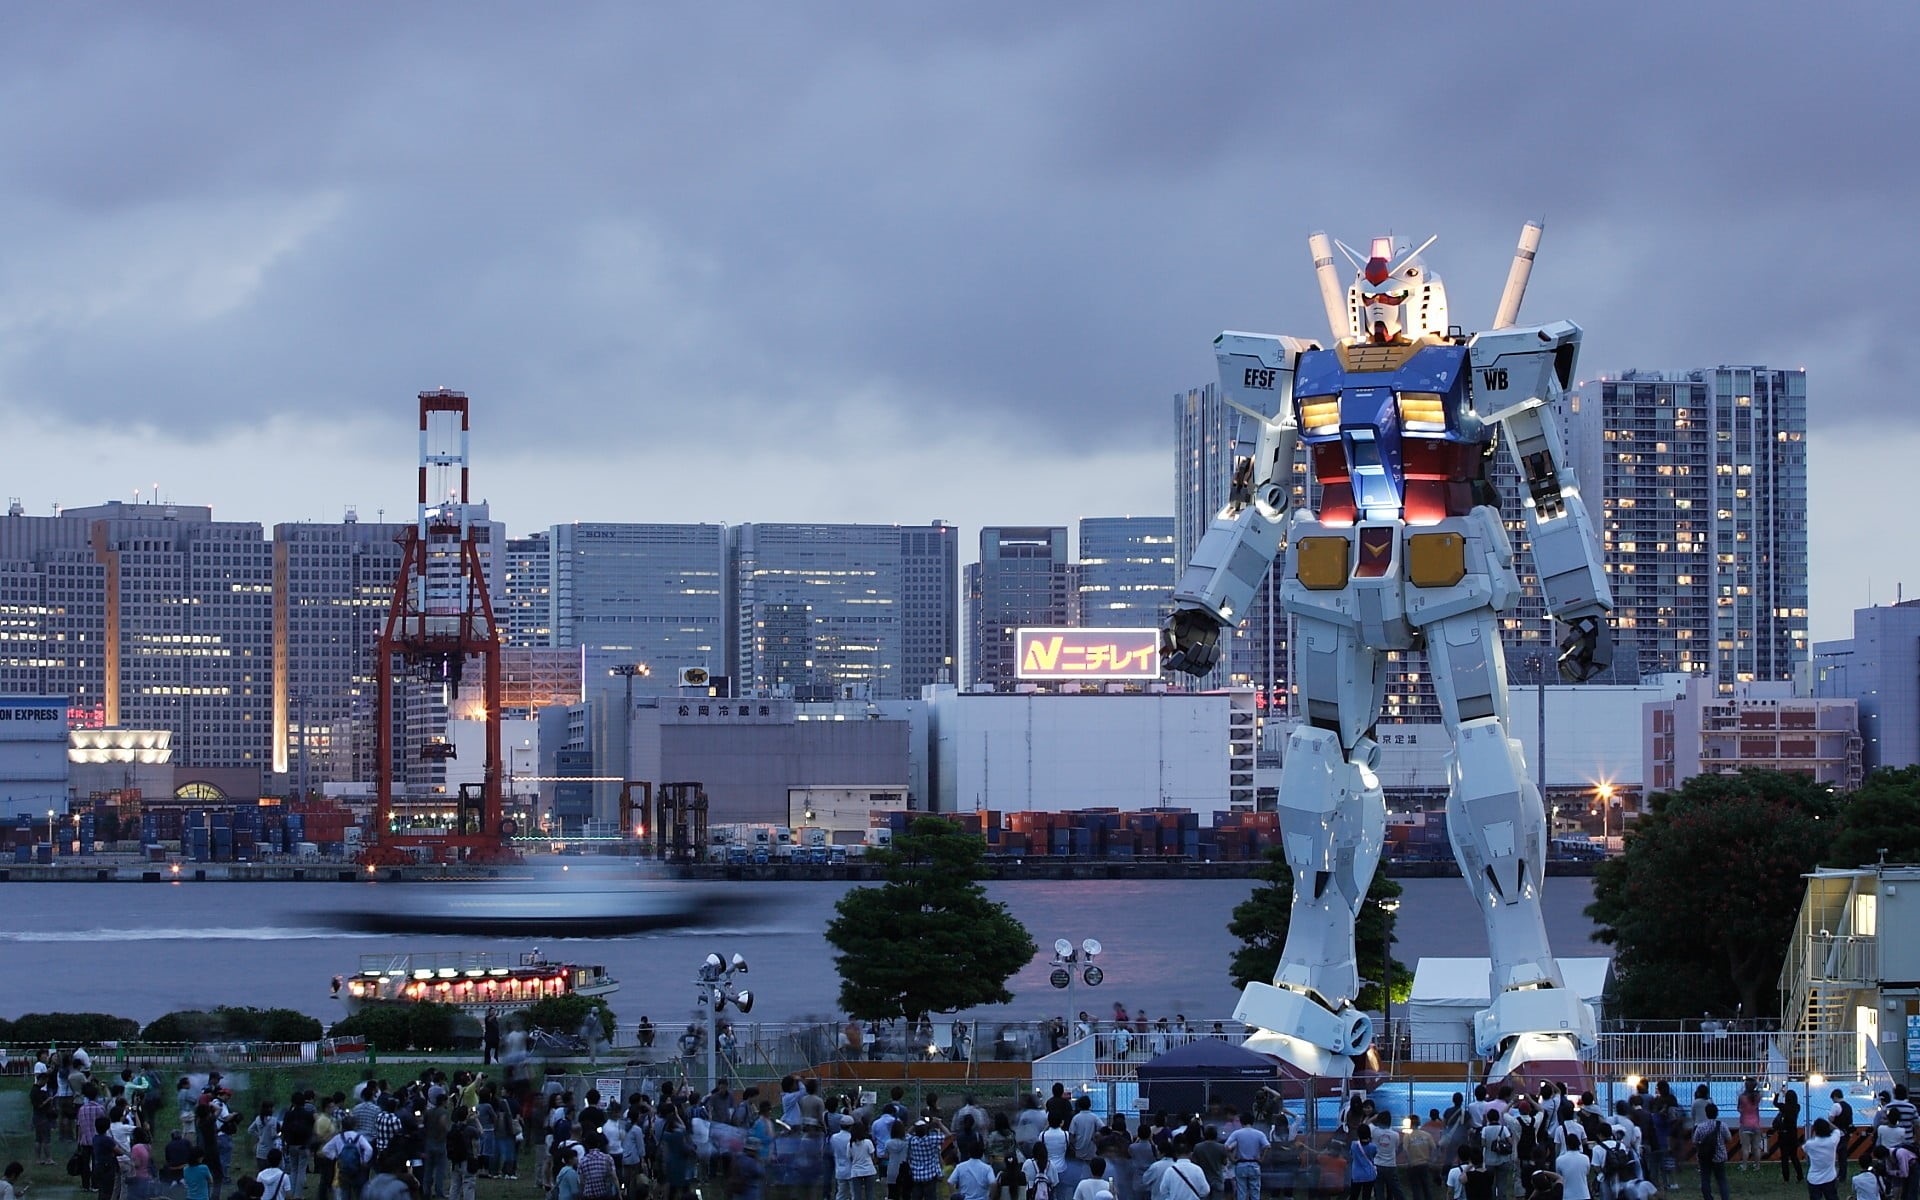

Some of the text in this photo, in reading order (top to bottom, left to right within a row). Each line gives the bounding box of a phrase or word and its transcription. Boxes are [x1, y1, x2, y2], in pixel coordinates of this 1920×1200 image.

[1244, 367, 1276, 388] EFSF
[1483, 370, 1509, 391] WB
[1061, 644, 1155, 671] ニチレイ
[15, 708, 58, 721] EXPRESS
[1376, 734, 1417, 744] 京定温
